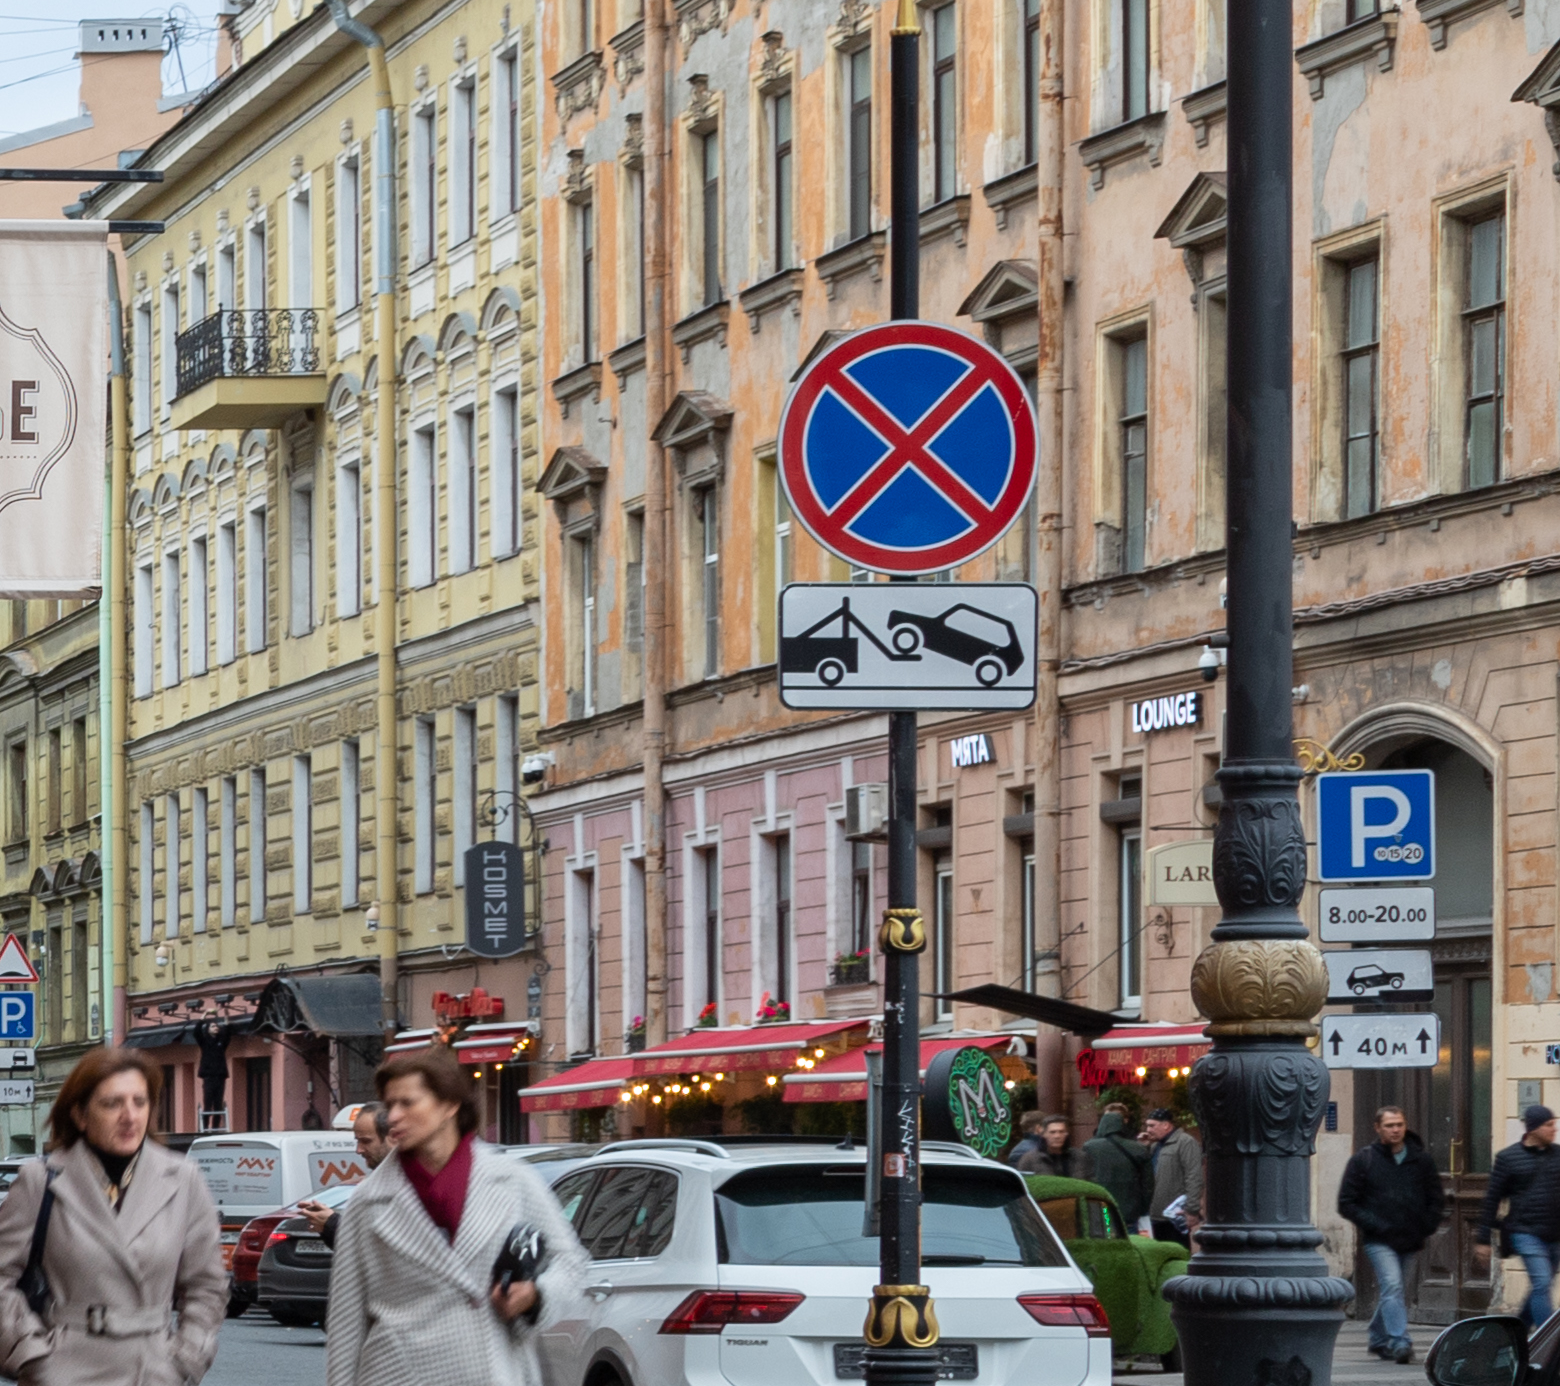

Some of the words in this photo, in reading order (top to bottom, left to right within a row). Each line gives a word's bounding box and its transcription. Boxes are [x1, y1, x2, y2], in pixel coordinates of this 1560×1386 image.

[1132, 692, 1197, 733] LOUNGE
[951, 733, 990, 767] МЯТА
[1350, 785, 1411, 868] P
[1404, 847, 1421, 860] 20
[483, 850, 508, 948] KOSMET
[1329, 905, 1427, 924] 8.00-20.00
[1, 997, 26, 1034] P
